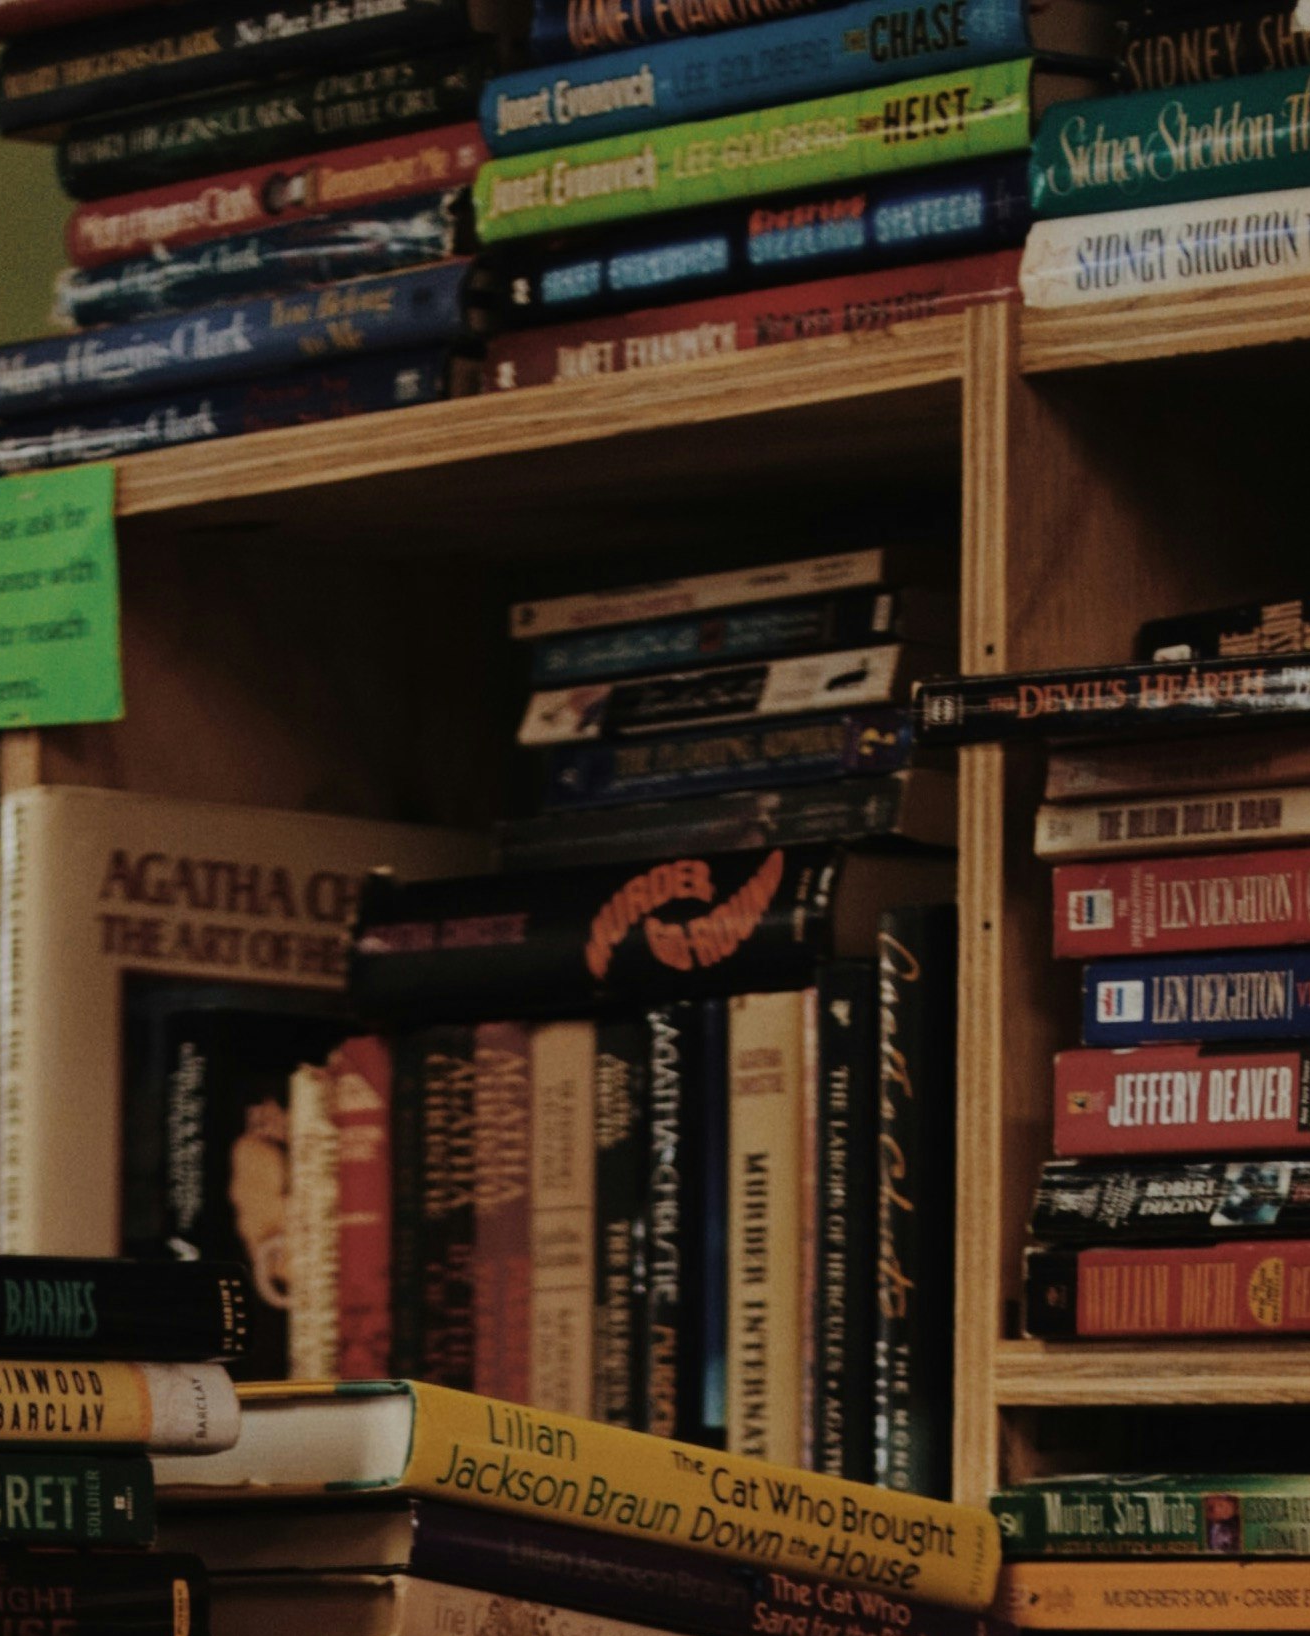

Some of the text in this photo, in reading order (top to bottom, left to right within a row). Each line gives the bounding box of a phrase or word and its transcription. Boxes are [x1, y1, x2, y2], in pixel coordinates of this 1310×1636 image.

[870, 0, 969, 62] CHASE
[883, 87, 971, 142] HEIST
[1076, 236, 1168, 292] SIDNEY
[1176, 208, 1299, 280] SHELDON
[100, 849, 297, 919] AGATHA
[1107, 1065, 1293, 1129] JEFFERY DEAVER
[3, 1279, 99, 1338] BARNES
[487, 1405, 577, 1462] Lilian
[87, 1467, 103, 1539] SOLDIER
[437, 1444, 682, 1536] Jackson Braun
[671, 1450, 957, 1559] The Cat Who Brought
[690, 1509, 922, 1590] Down the House
